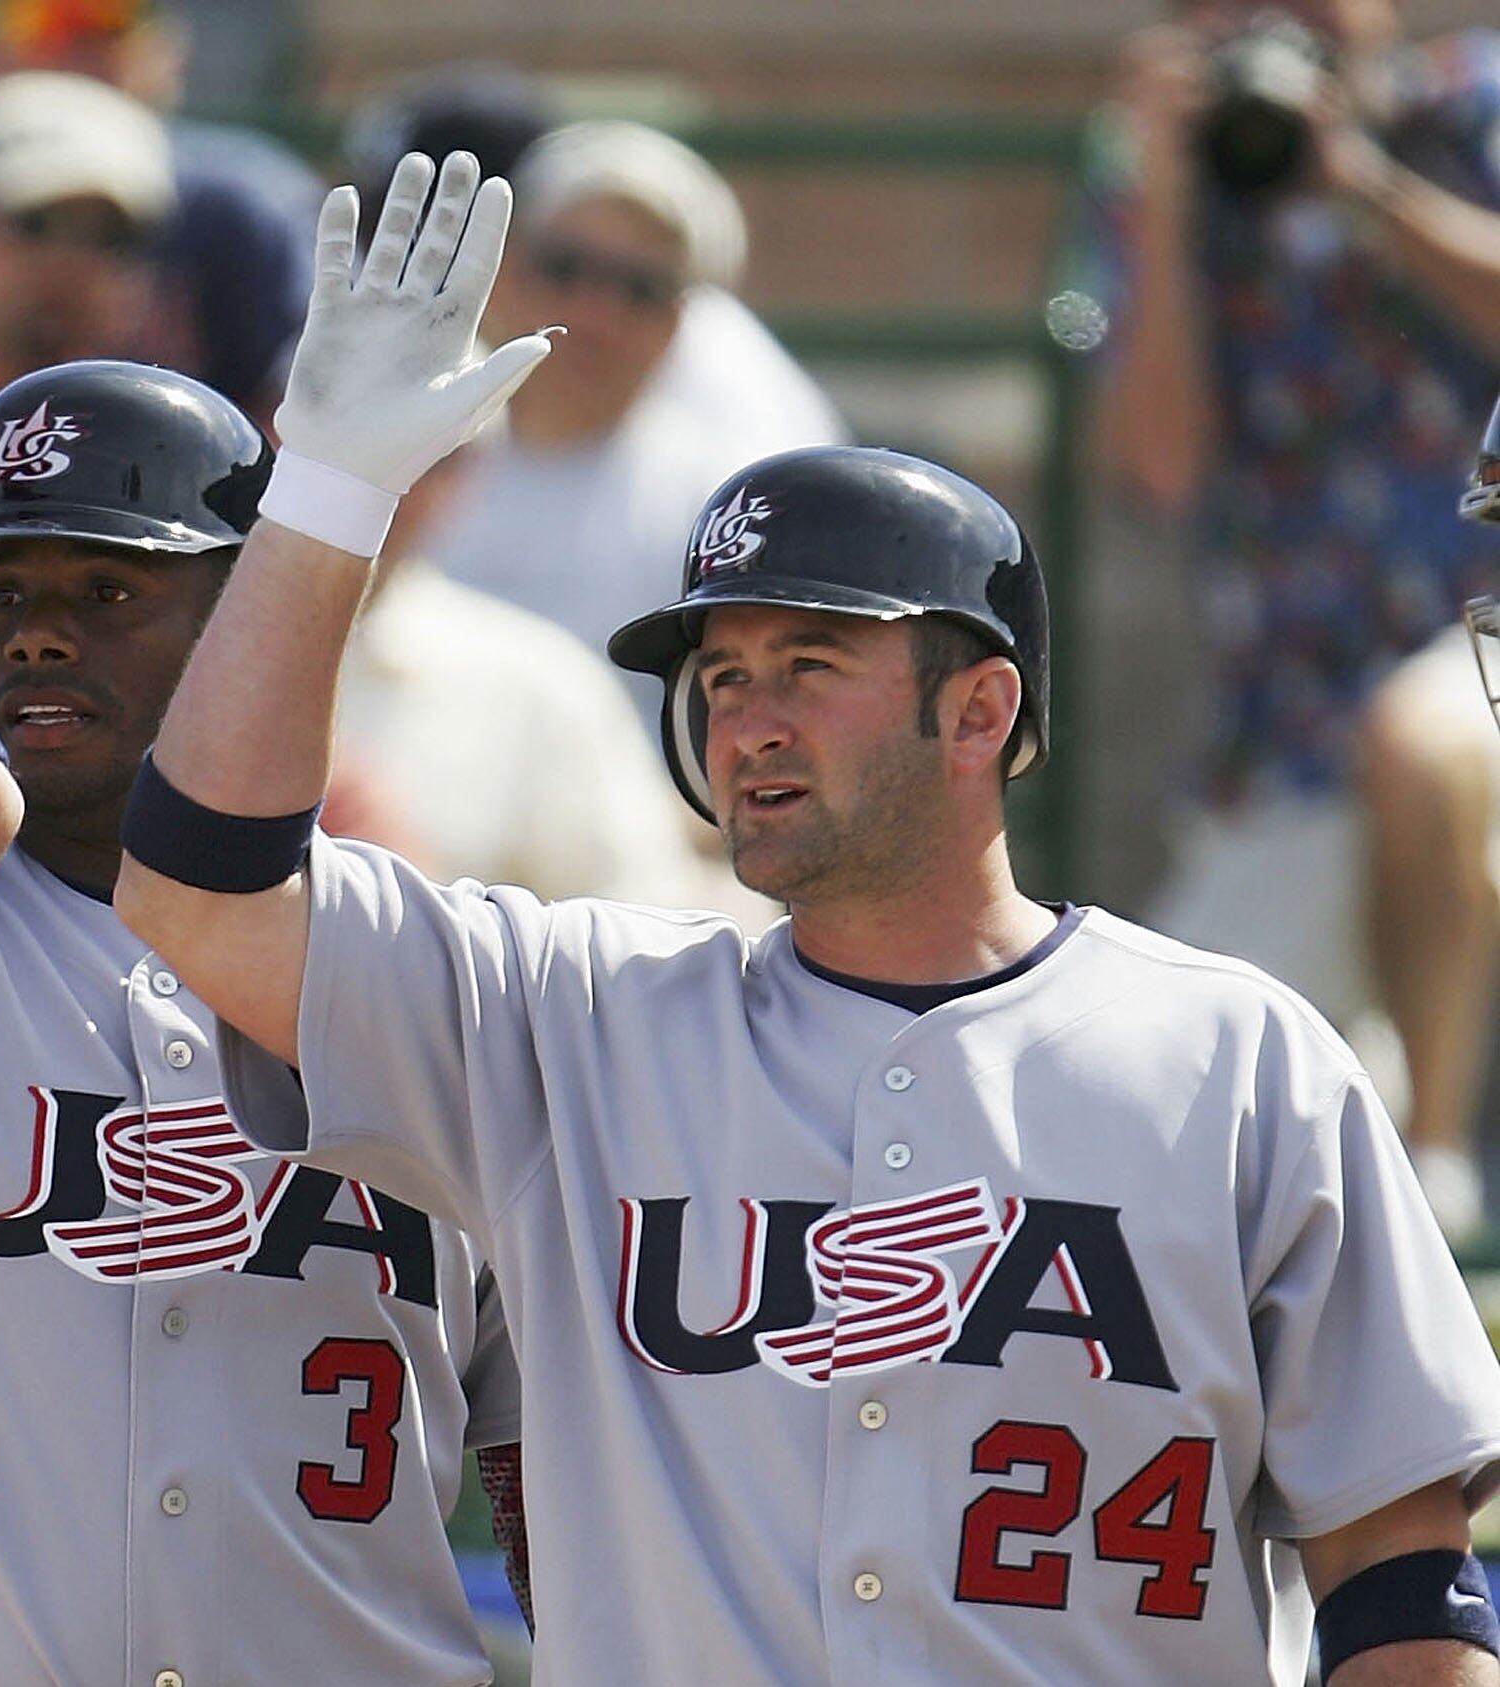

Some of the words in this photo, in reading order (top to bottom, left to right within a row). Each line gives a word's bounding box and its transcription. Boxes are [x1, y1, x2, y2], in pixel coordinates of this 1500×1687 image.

[617, 1176, 1181, 1393] USA
[296, 1337, 406, 1525] 3
[954, 1419, 1217, 1621] 24
